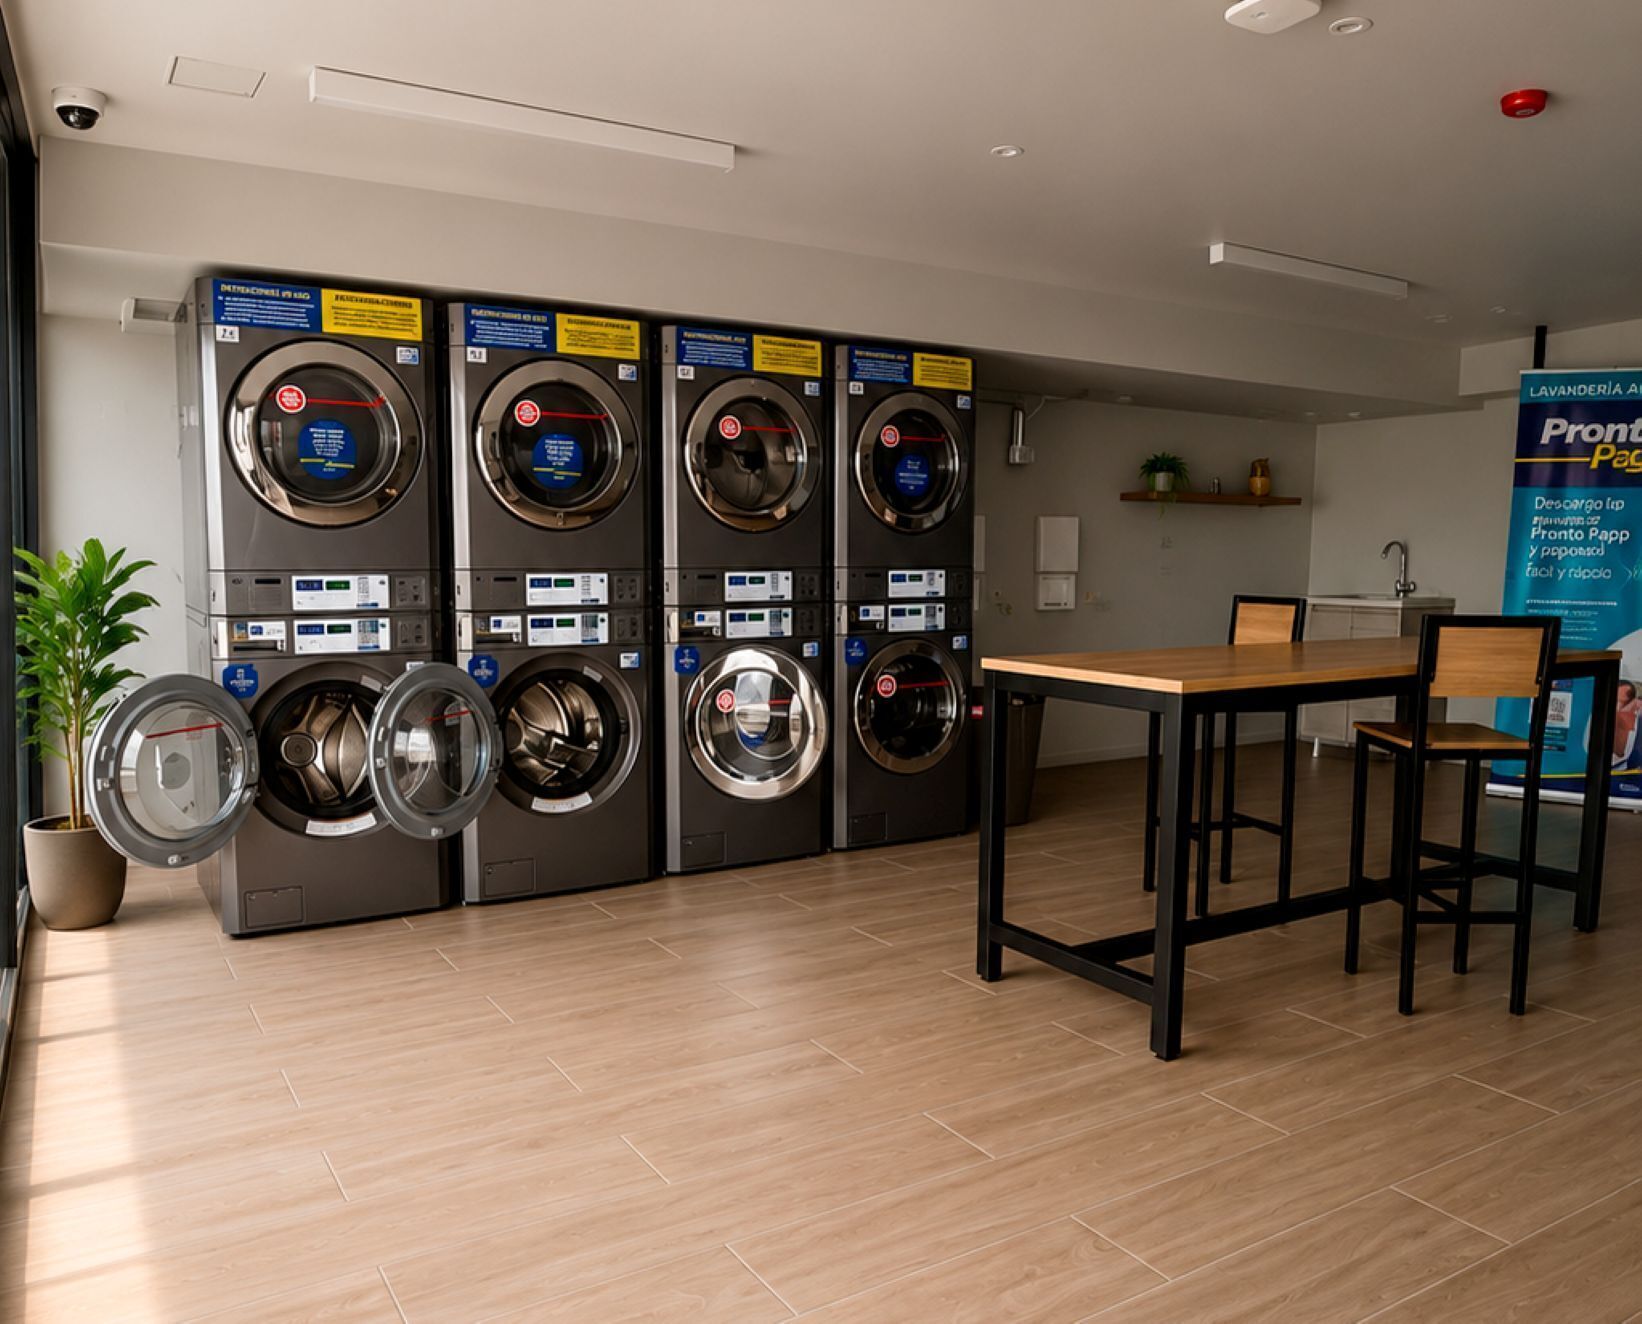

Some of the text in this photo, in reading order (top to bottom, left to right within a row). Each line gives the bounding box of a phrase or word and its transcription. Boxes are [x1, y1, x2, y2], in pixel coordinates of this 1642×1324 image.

[1530, 381, 1642, 397] LAVANDERÍA A
[1530, 527, 1585, 541] Pronto
